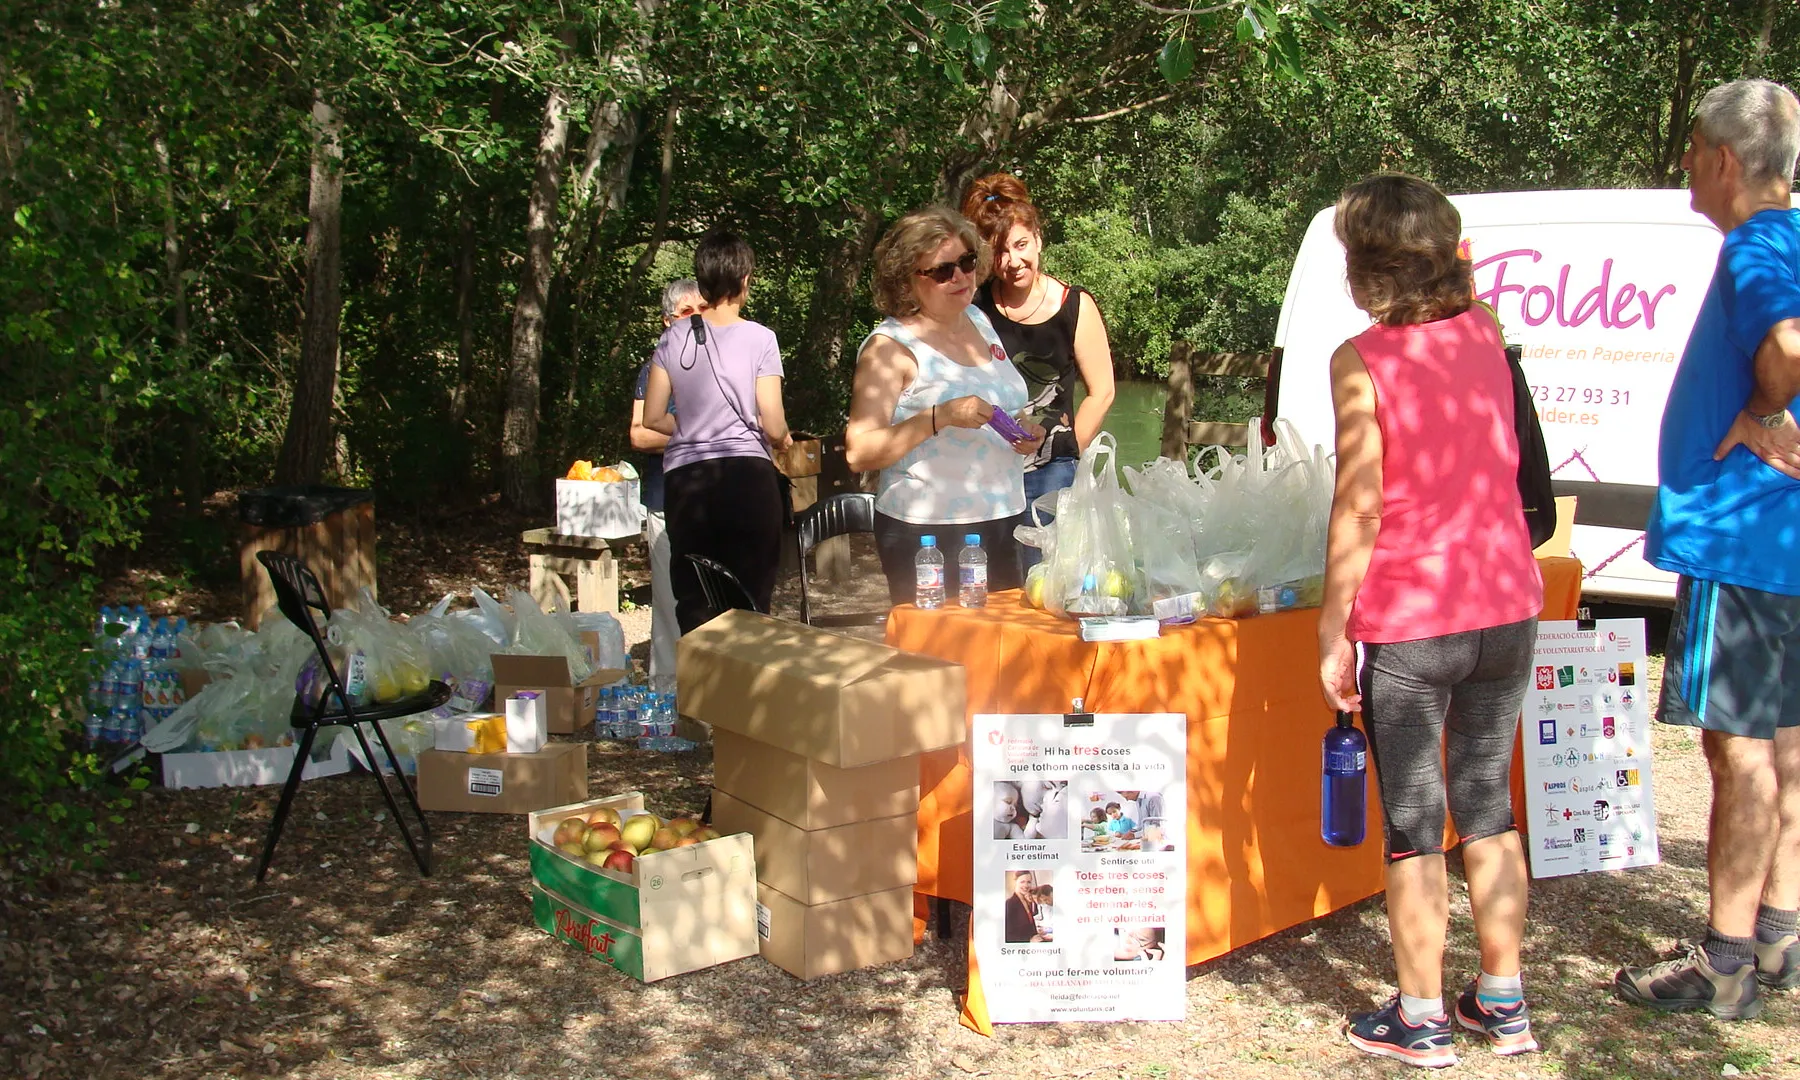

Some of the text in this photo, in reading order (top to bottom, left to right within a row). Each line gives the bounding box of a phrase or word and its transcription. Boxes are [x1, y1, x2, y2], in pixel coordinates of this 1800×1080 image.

[1472, 249, 1677, 330] Folder
[1566, 348, 1587, 360] en
[1555, 386, 1576, 402] 27
[1583, 388, 1603, 404] 93
[1610, 389, 1630, 405] 31
[1535, 406, 1599, 425] lder.es
[1044, 745, 1131, 756] Hi ha tres coses
[1010, 764, 1029, 773] que
[1032, 763, 1068, 772] tothom
[1071, 762, 1120, 771] necessita
[1132, 762, 1140, 771] la
[1013, 843, 1046, 852] Estimar
[1011, 853, 1025, 861] ser
[1027, 852, 1059, 860] estimat
[1100, 857, 1139, 865] Sentir-se
[1075, 871, 1168, 881] Totes tres coses,
[1077, 887, 1091, 895] es
[1132, 886, 1165, 894] sense
[1107, 914, 1166, 923] voluntariat
[1001, 947, 1061, 957] Ser reconegut
[1018, 967, 1154, 978] Com puc fer-me voluntari?
